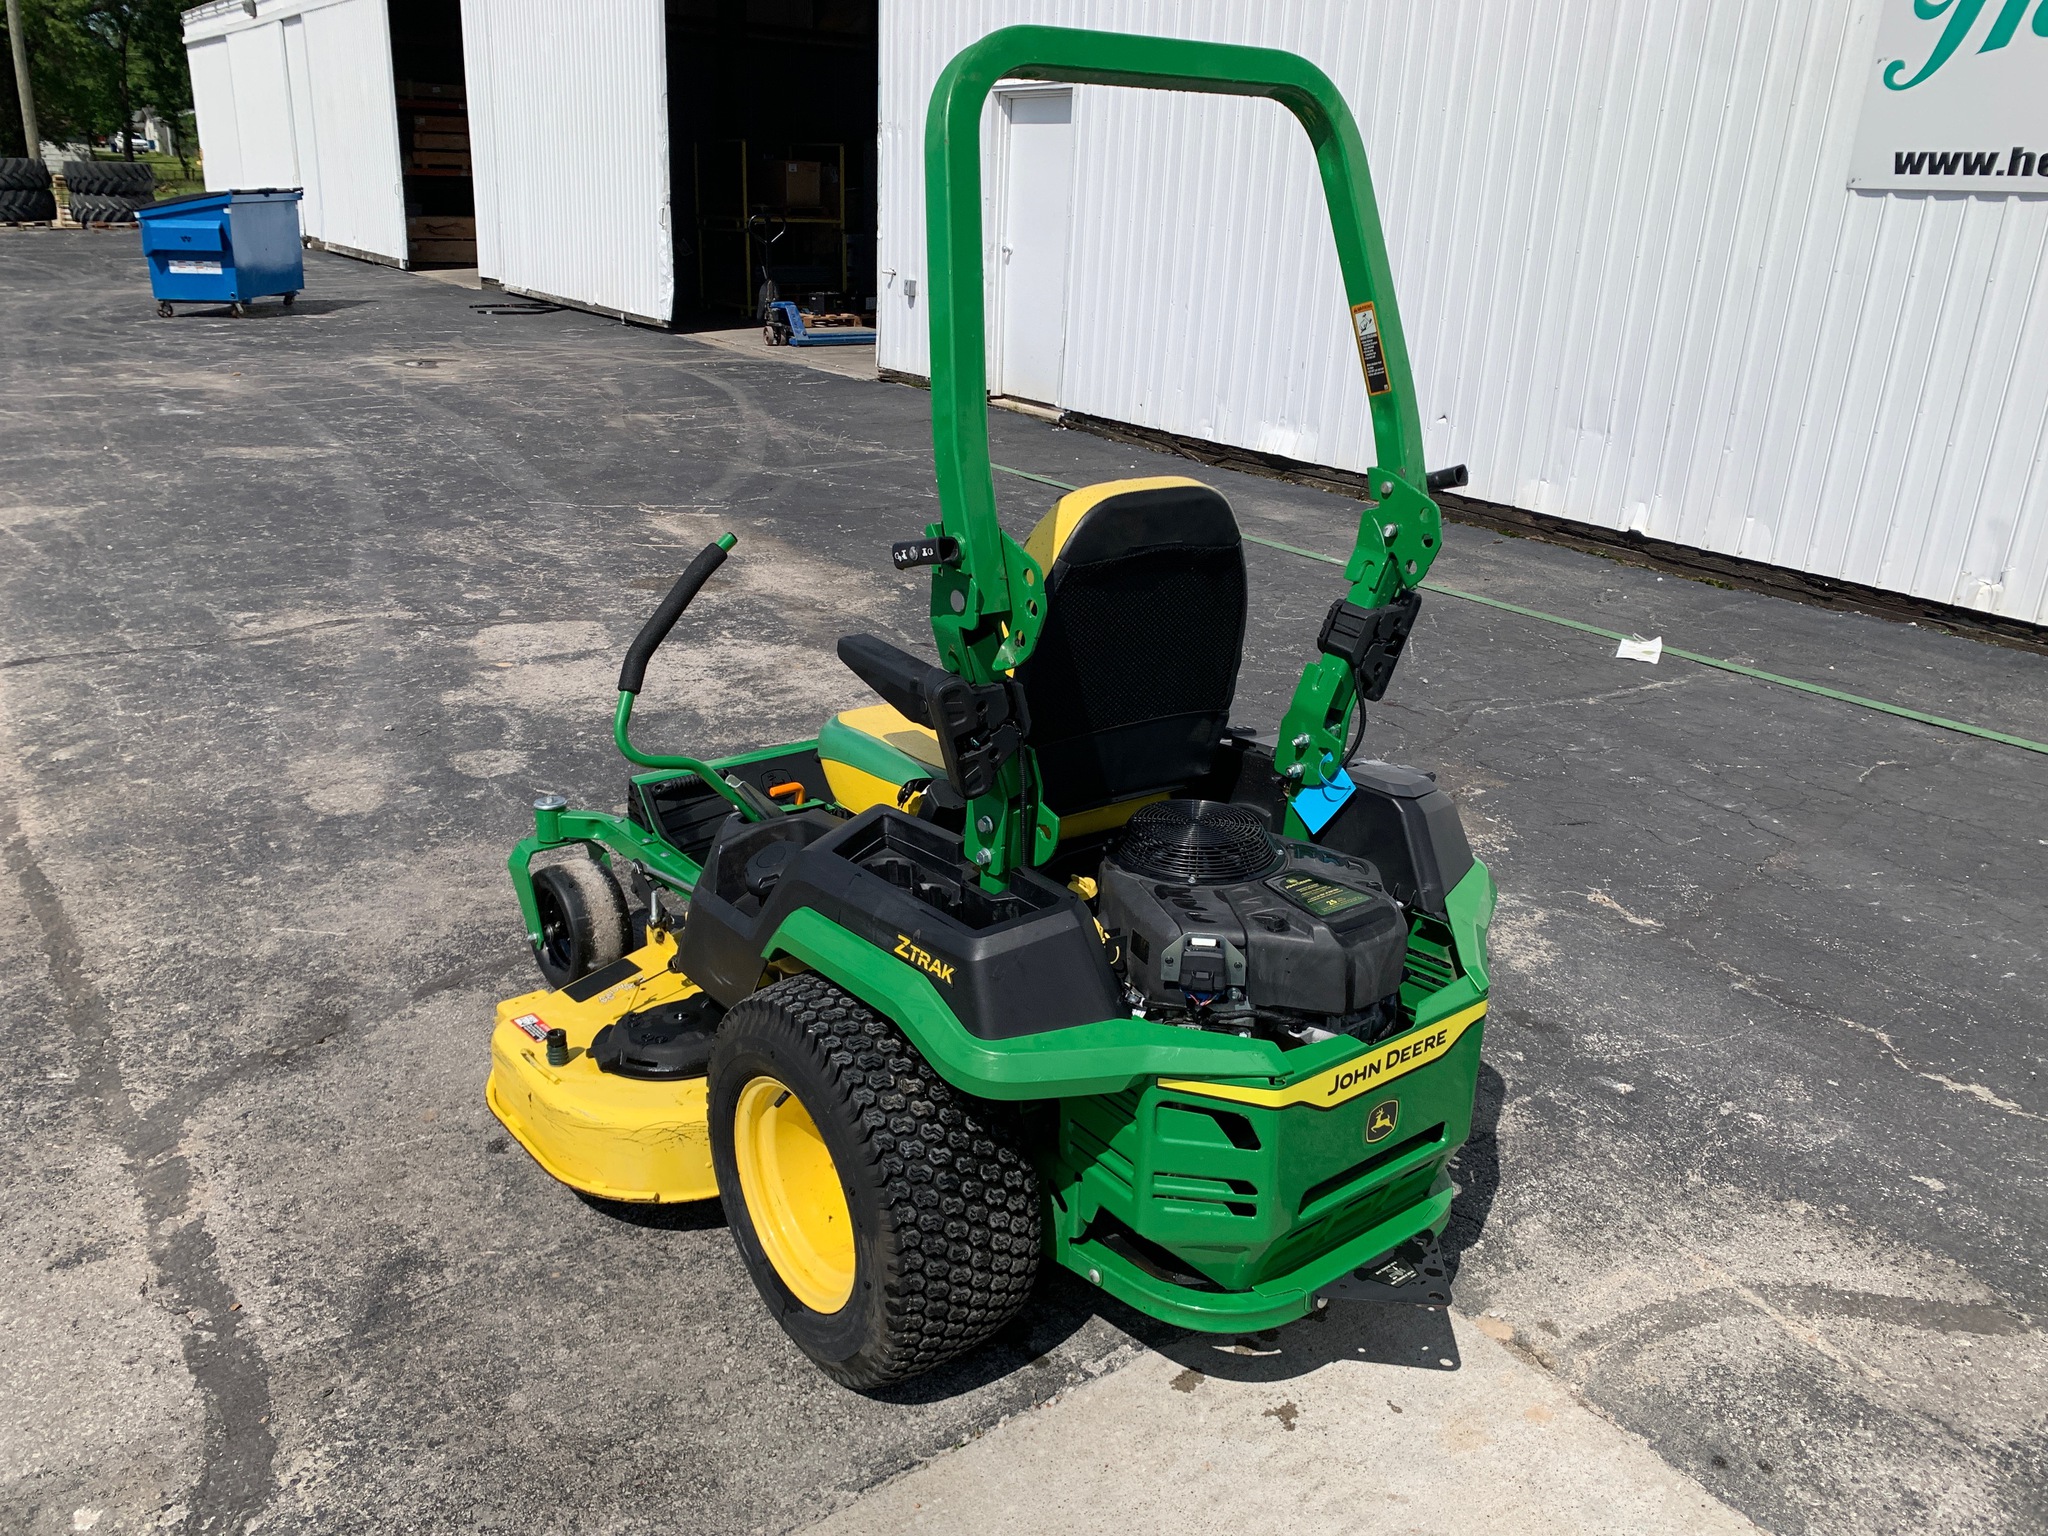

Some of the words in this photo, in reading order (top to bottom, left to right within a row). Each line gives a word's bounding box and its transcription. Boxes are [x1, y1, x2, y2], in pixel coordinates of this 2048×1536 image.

[893, 934, 955, 984] ZTRAK
[1327, 1059, 1382, 1096] JOHN
[1385, 1029, 1448, 1070] DEERE
